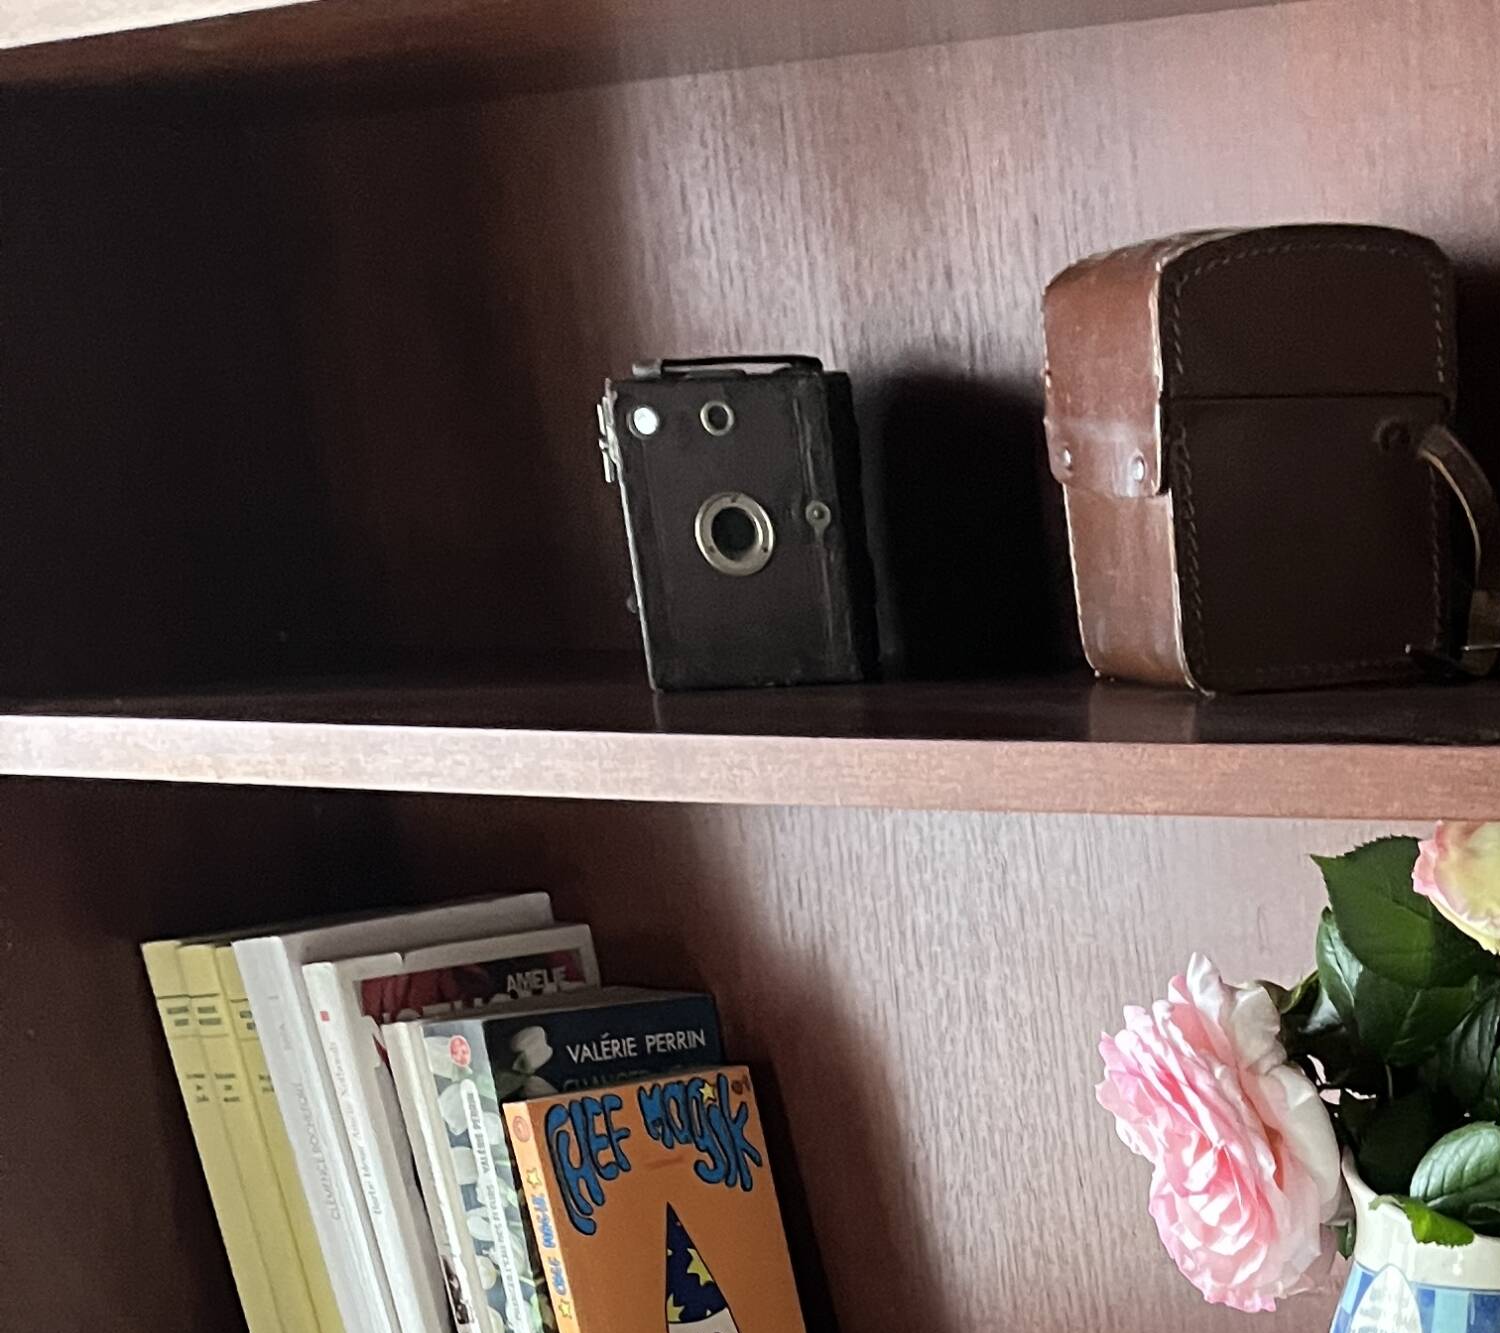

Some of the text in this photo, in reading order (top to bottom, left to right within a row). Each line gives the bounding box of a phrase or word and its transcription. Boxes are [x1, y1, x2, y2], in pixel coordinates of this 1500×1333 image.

[566, 1029, 706, 1064] VALÉRIE PERRIN
[545, 1094, 631, 1235] CHEF
